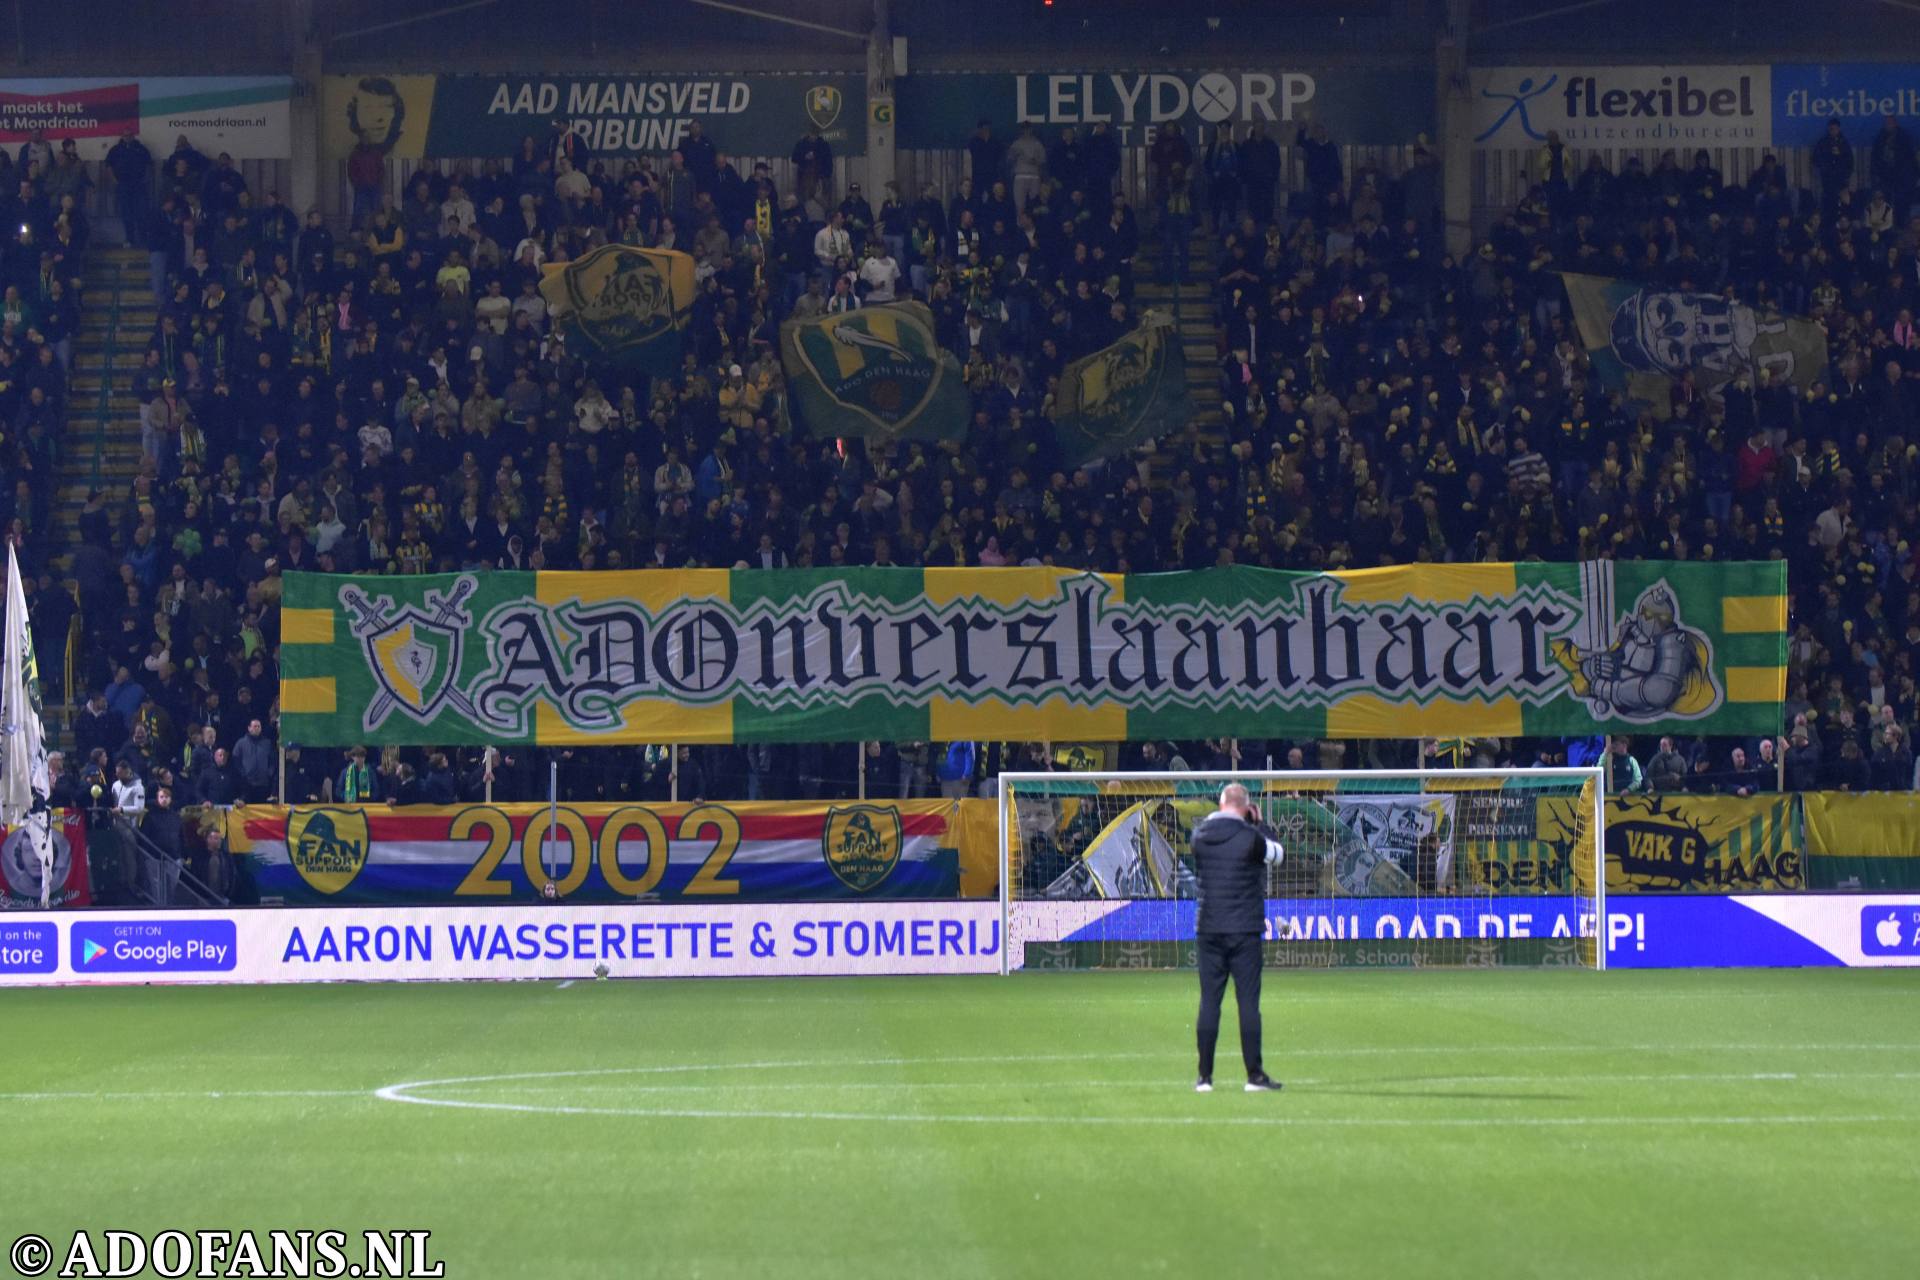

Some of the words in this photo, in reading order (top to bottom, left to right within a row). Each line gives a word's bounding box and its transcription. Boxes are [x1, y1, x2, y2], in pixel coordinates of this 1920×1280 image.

[488, 83, 559, 113] AAD
[567, 82, 751, 114] MANSVELD
[1564, 76, 1754, 118] flexibel
[3, 102, 53, 115] maakt
[57, 102, 84, 114] het
[874, 105, 891, 122] G
[14, 116, 98, 129] Mondriaan
[168, 116, 266, 130] rocmondriaan.nl
[1566, 121, 1756, 140] uitzendbureau
[298, 839, 361, 857] FAN
[449, 804, 741, 897] 2002
[1625, 829, 1674, 863] VAK
[1681, 837, 1696, 864] G
[296, 856, 361, 866] SUPPORT
[5, 932, 20, 941] on
[23, 929, 42, 941] the
[114, 927, 133, 937] GET
[135, 927, 144, 937] IT
[145, 926, 162, 937] ON
[282, 925, 432, 962] AARON
[448, 922, 733, 961] WASSERETTE
[750, 921, 776, 958] &
[793, 920, 999, 957] STOMERIJ
[0, 948, 43, 964] tore
[113, 940, 182, 965] Google
[187, 940, 228, 964] Play
[1275, 950, 1349, 966] Slimmer.
[1355, 948, 1432, 966] Schoner.
